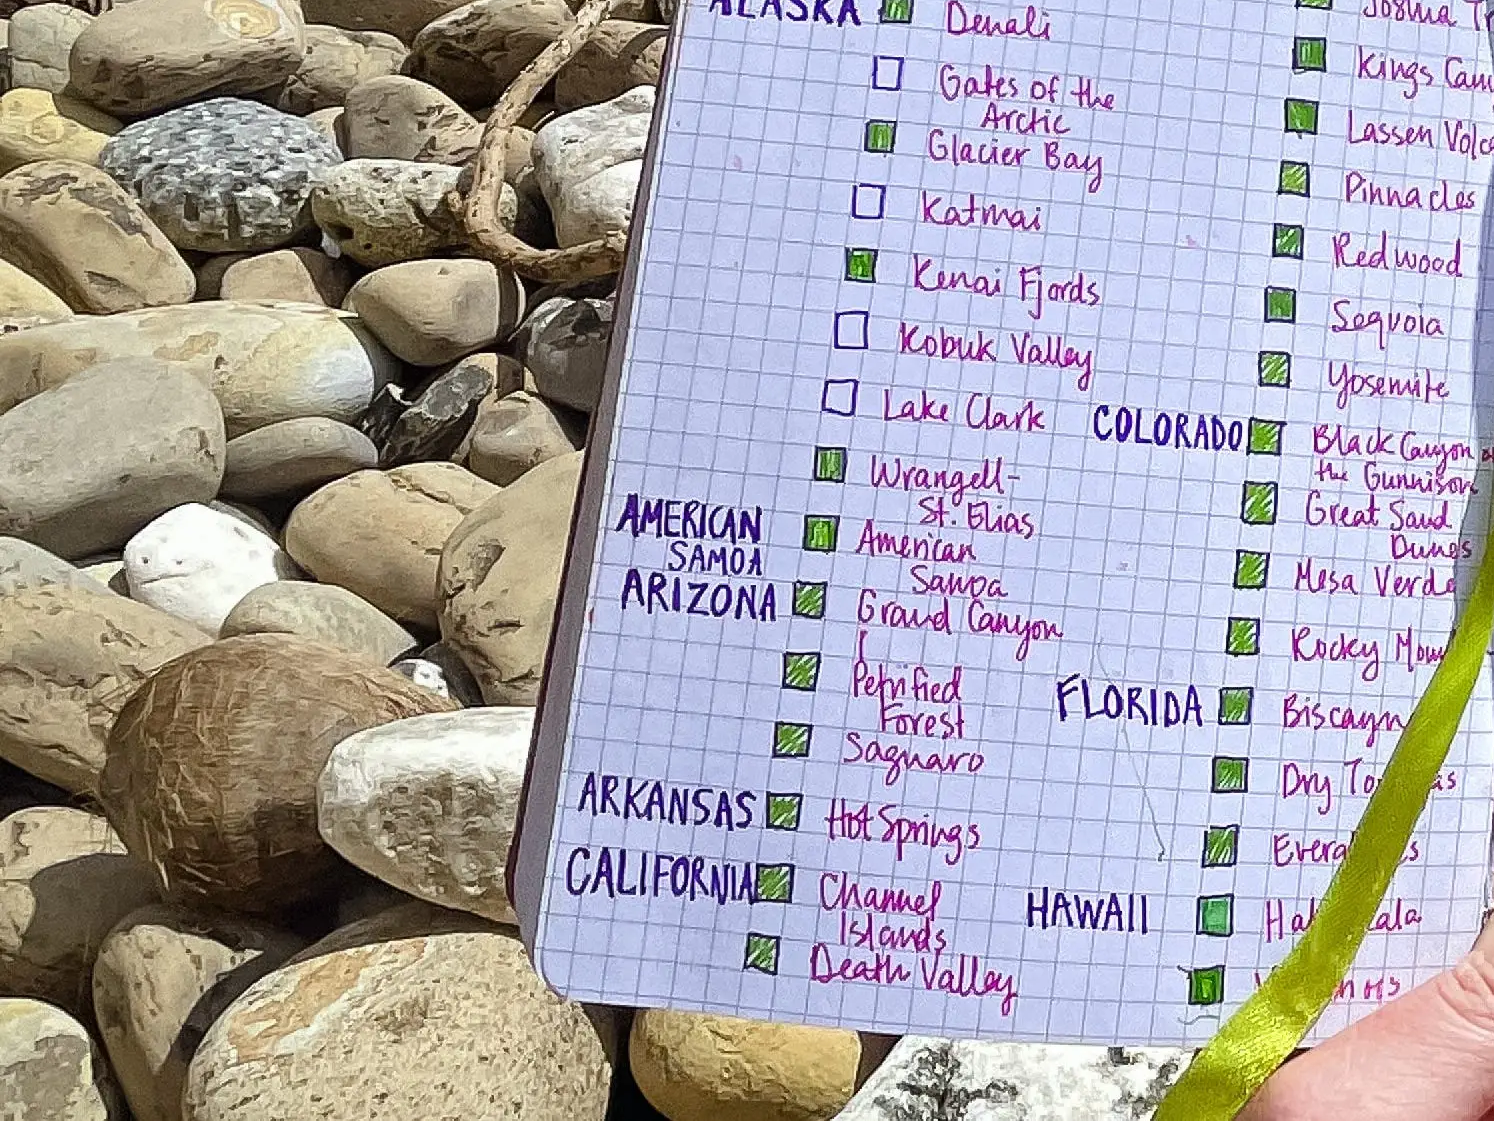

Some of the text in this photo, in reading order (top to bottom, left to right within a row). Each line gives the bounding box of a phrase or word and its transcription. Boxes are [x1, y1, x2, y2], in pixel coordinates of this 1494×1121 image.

[946, 0, 1050, 40] Denali
[940, 65, 1115, 110] Gates of the
[1357, 45, 1434, 100] Kings
[981, 103, 1070, 134] Arctic
[1348, 109, 1433, 148] Lassen
[928, 130, 1102, 192] Glacier Bay
[921, 190, 1042, 231] Katmai
[1345, 170, 1475, 212] Pinnacles
[1332, 230, 1462, 277] Redwood
[913, 254, 1101, 318] Kenai Fjords
[1332, 299, 1444, 351] Sequoia
[899, 322, 1093, 391] Kobuk Valley
[1328, 360, 1449, 410] Yosemite
[884, 389, 1045, 431] Lake Clark
[1094, 404, 1243, 451] COLORADO
[1313, 423, 1395, 457] Black
[1400, 431, 1474, 477] Canyon
[1315, 459, 1478, 495] the Gunnison
[616, 493, 762, 543] AMERICAN
[919, 497, 1034, 539] St. Elias
[1305, 489, 1452, 531] Great Sand
[668, 540, 762, 576] SAMOA
[856, 519, 976, 562] American
[1391, 534, 1472, 560] Dunes
[622, 569, 776, 621] ARIZONA
[1295, 561, 1358, 596] Mesa
[857, 588, 1063, 661] Grand Canyon
[854, 645, 963, 703] Petrified
[1292, 626, 1379, 681] Rocky
[881, 702, 964, 739] Forest
[1056, 674, 1202, 727] FLORIDA
[1283, 692, 1407, 748] Biscayn
[578, 772, 756, 831] ARKANSAS
[1283, 763, 1331, 815] Dry
[566, 847, 754, 905] CALIFORNIA
[819, 872, 942, 922] Channel
[839, 911, 947, 954] Islands
[1027, 886, 1149, 935] HAWAII
[811, 943, 1018, 1016] Death Valley
